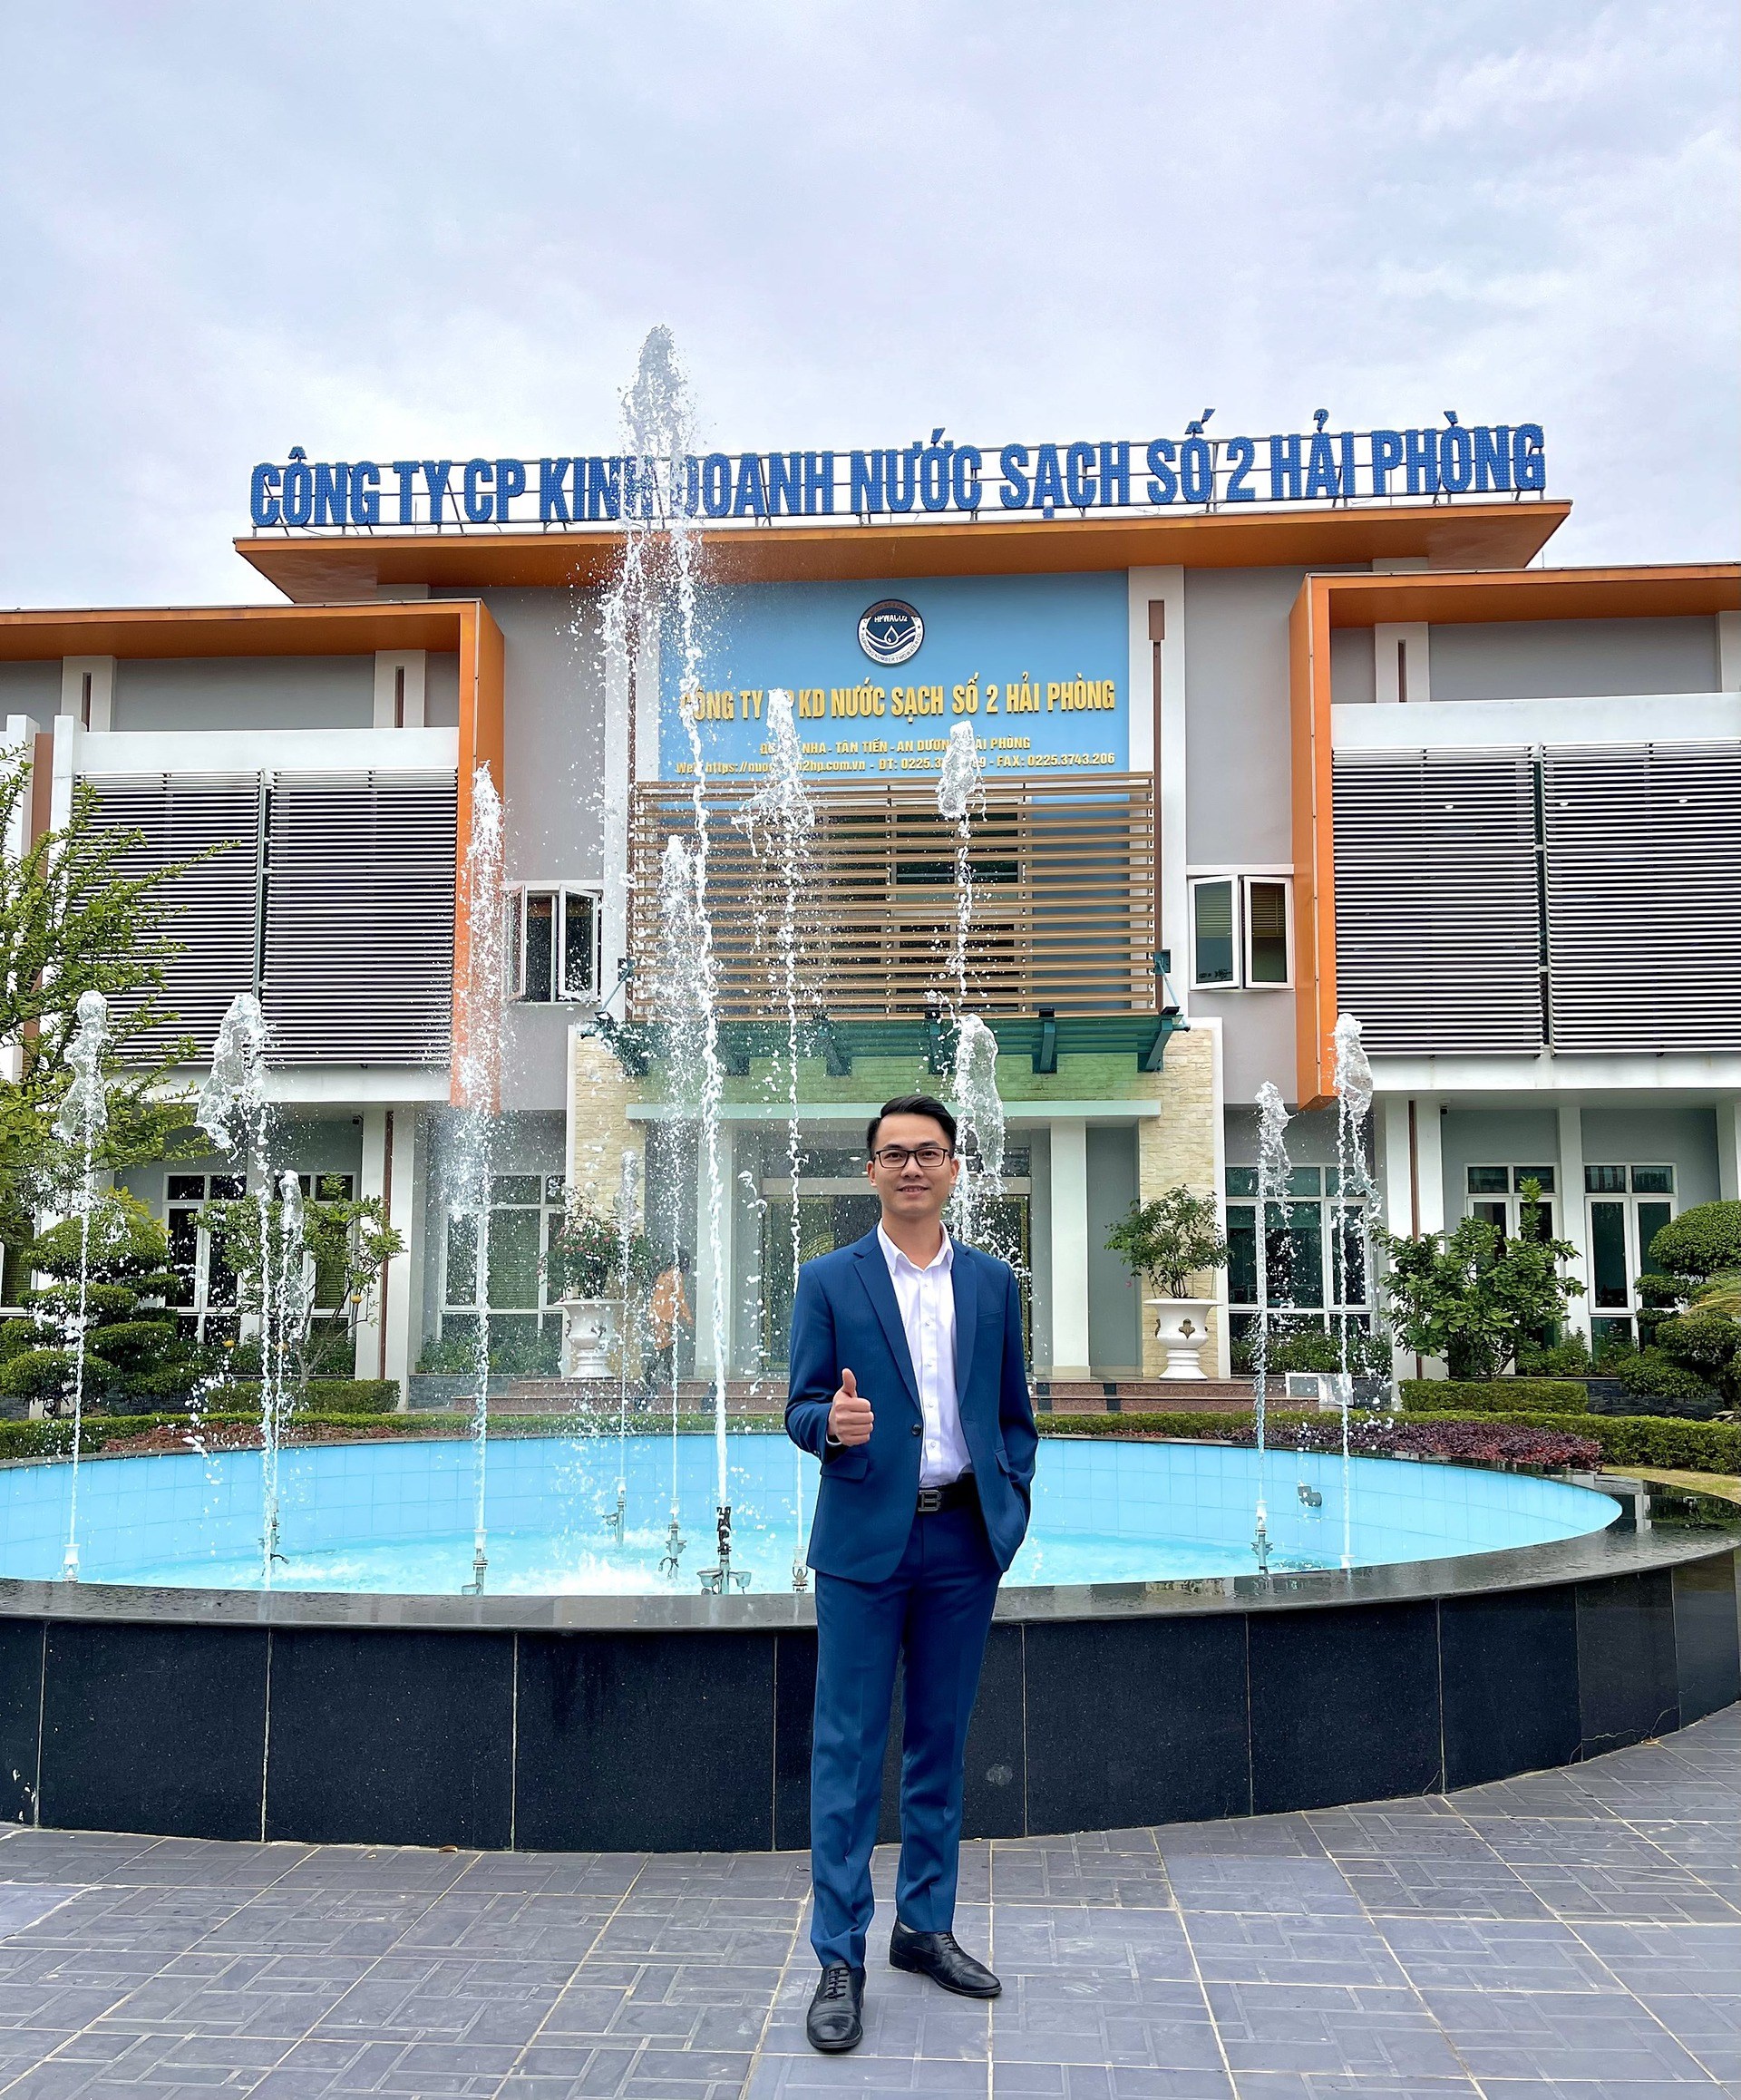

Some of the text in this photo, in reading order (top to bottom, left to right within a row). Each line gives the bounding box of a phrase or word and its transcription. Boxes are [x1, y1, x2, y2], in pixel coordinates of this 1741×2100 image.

[251, 446, 380, 526] CÔNG
[393, 460, 452, 526] TY
[463, 458, 526, 523] CP
[540, 455, 653, 522] KINH
[851, 427, 982, 515] NƯỚC
[999, 441, 1130, 520] SẠCH
[1146, 408, 1216, 504] SỐ
[1226, 436, 1255, 501] 2
[1269, 408, 1355, 501] HẢI
[1371, 410, 1546, 497] PHÒNG
[740, 690, 764, 719] TY
[799, 688, 825, 718] KD
[831, 676, 886, 717] NƯỚC
[890, 685, 944, 724] SẠCH
[952, 672, 978, 715] SỐ
[986, 684, 998, 714] 2
[1006, 671, 1040, 713] HẢI
[1047, 673, 1115, 712] PHÒNG
[836, 739, 859, 754] TÂN
[862, 736, 888, 753] TIẾN
[897, 740, 913, 753] AN
[917, 738, 953, 753] DƯƠN
[969, 734, 987, 751] ẢI
[990, 734, 1030, 750] PHÒNG
[997, 754, 1026, 768] FAX:
[1027, 753, 1115, 768] 0225.3743.206
